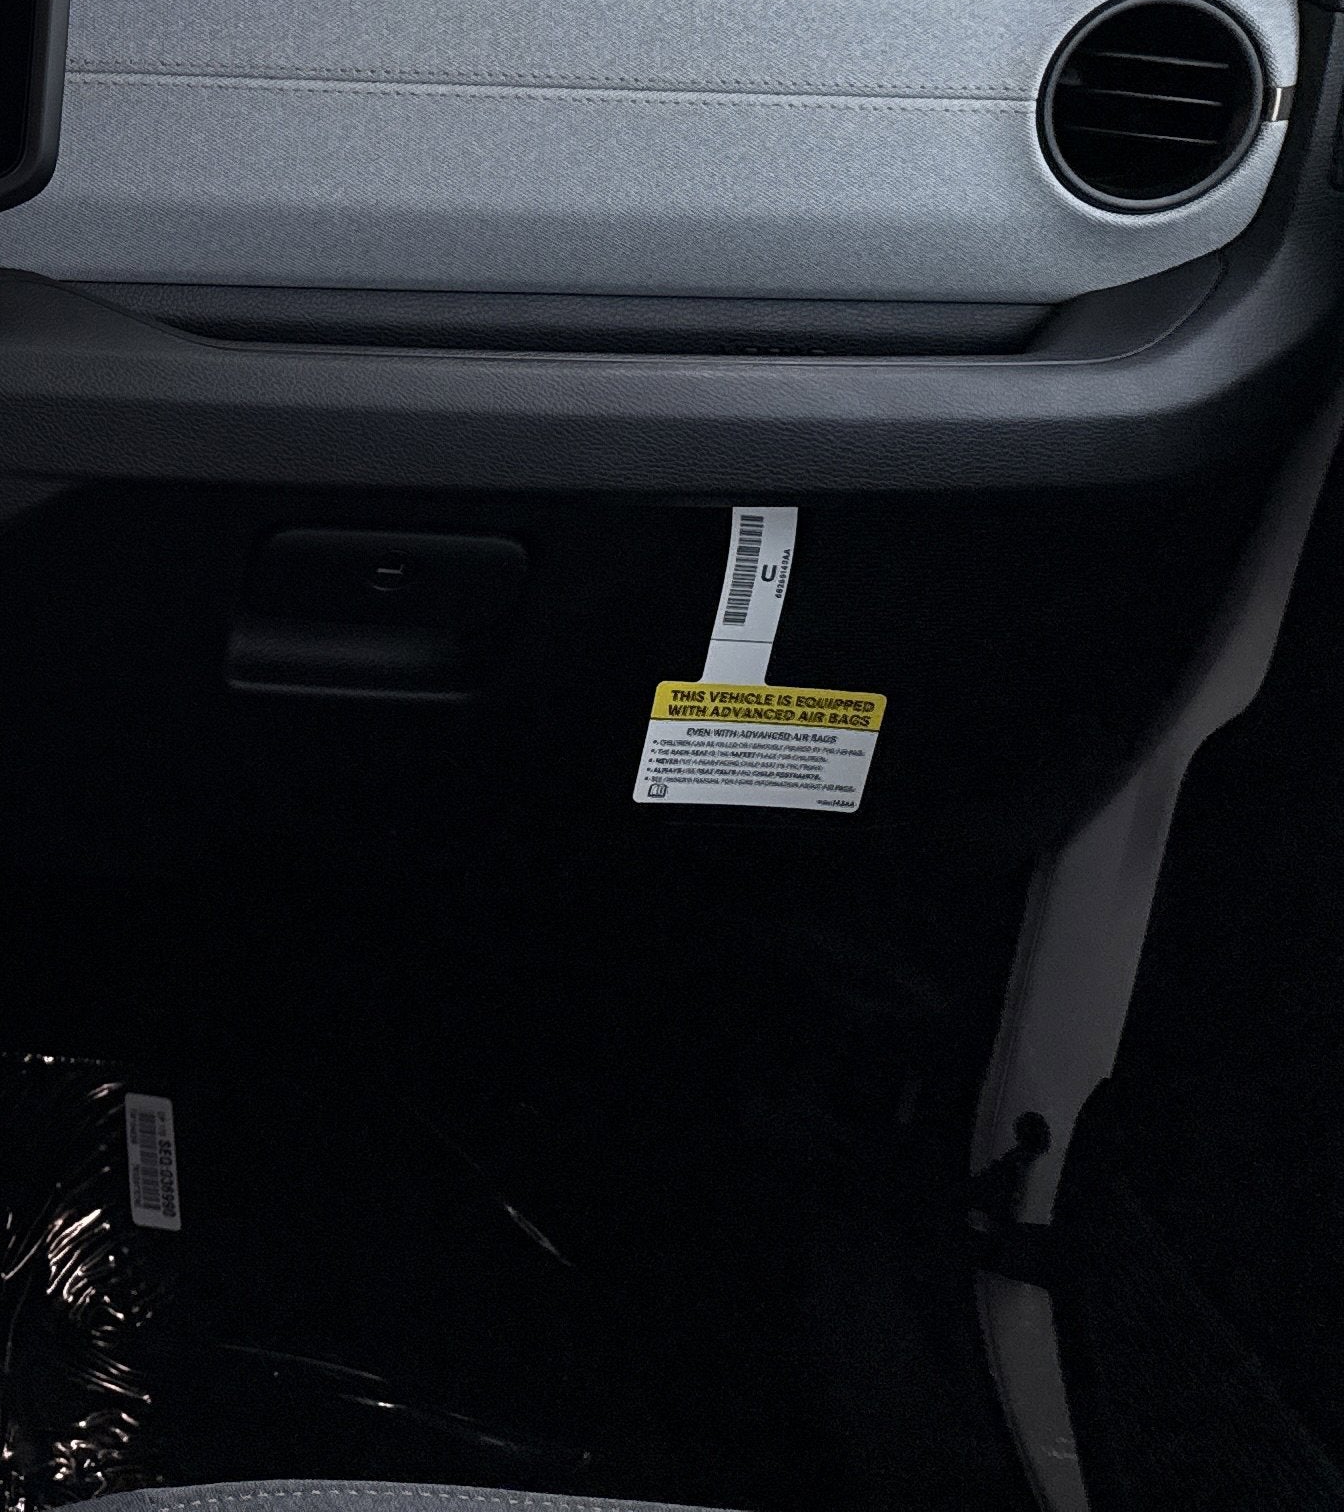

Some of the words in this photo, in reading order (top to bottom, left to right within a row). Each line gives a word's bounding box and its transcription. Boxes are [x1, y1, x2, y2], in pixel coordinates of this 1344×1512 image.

[671, 689, 706, 703] THIS
[709, 691, 774, 706] VEHICLE
[776, 694, 793, 707] IS
[796, 695, 876, 713] EQUIPPED
[668, 704, 707, 717] WITH
[711, 706, 795, 722] ADVANCED
[798, 710, 826, 724] AIR
[828, 713, 871, 727] BAGS
[686, 727, 712, 737] EVEN
[713, 728, 736, 738] WITH
[738, 730, 792, 741] ADVANCED
[792, 733, 809, 742] AIR
[810, 734, 838, 744] BAGS
